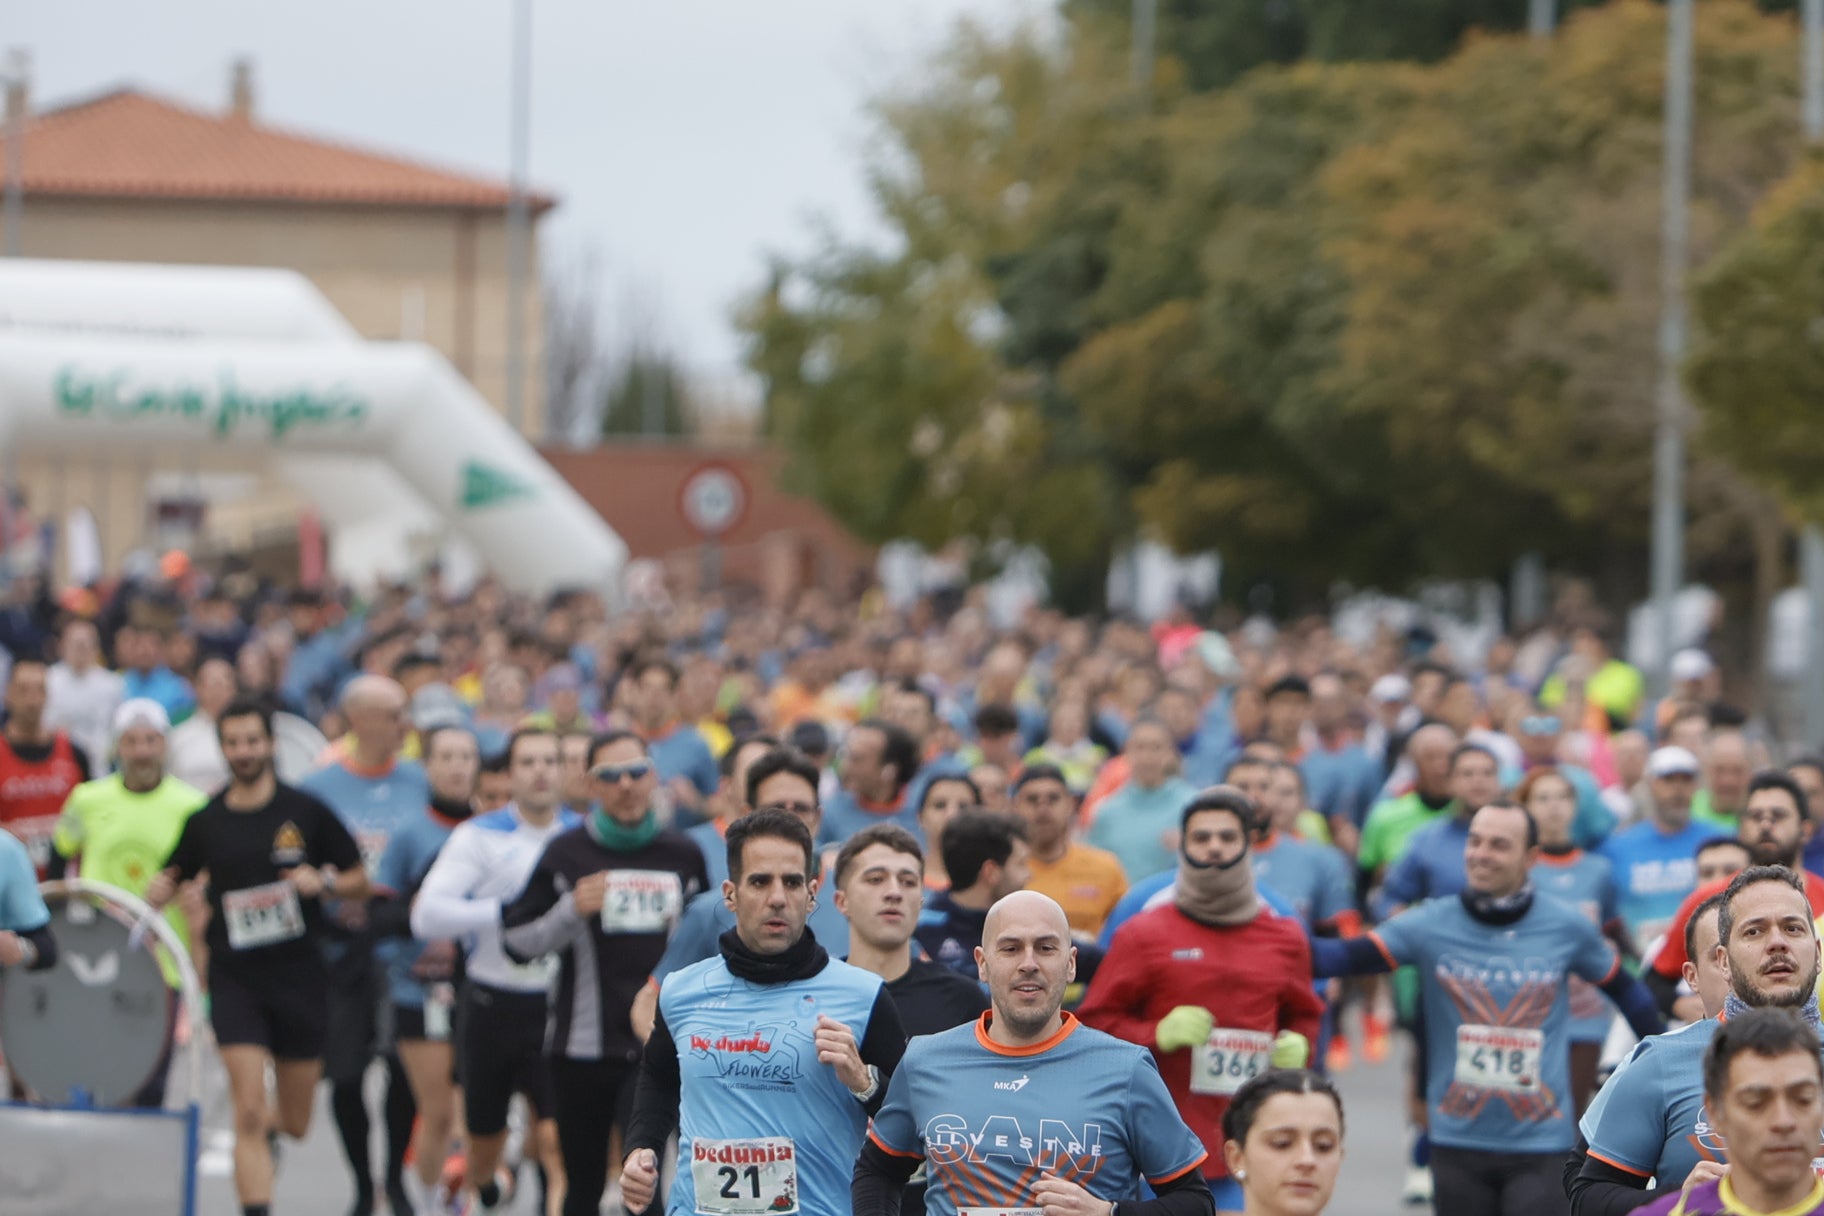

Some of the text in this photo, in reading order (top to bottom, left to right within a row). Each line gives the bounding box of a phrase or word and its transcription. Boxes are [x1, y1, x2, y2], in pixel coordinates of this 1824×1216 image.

[726, 1060, 791, 1080] FLOWERS
[1471, 1048, 1525, 1074] 418
[994, 1081, 1016, 1091] MKA
[694, 1142, 792, 1163] bedunia
[925, 1114, 1101, 1174] SAN
[718, 1165, 761, 1199] 21
